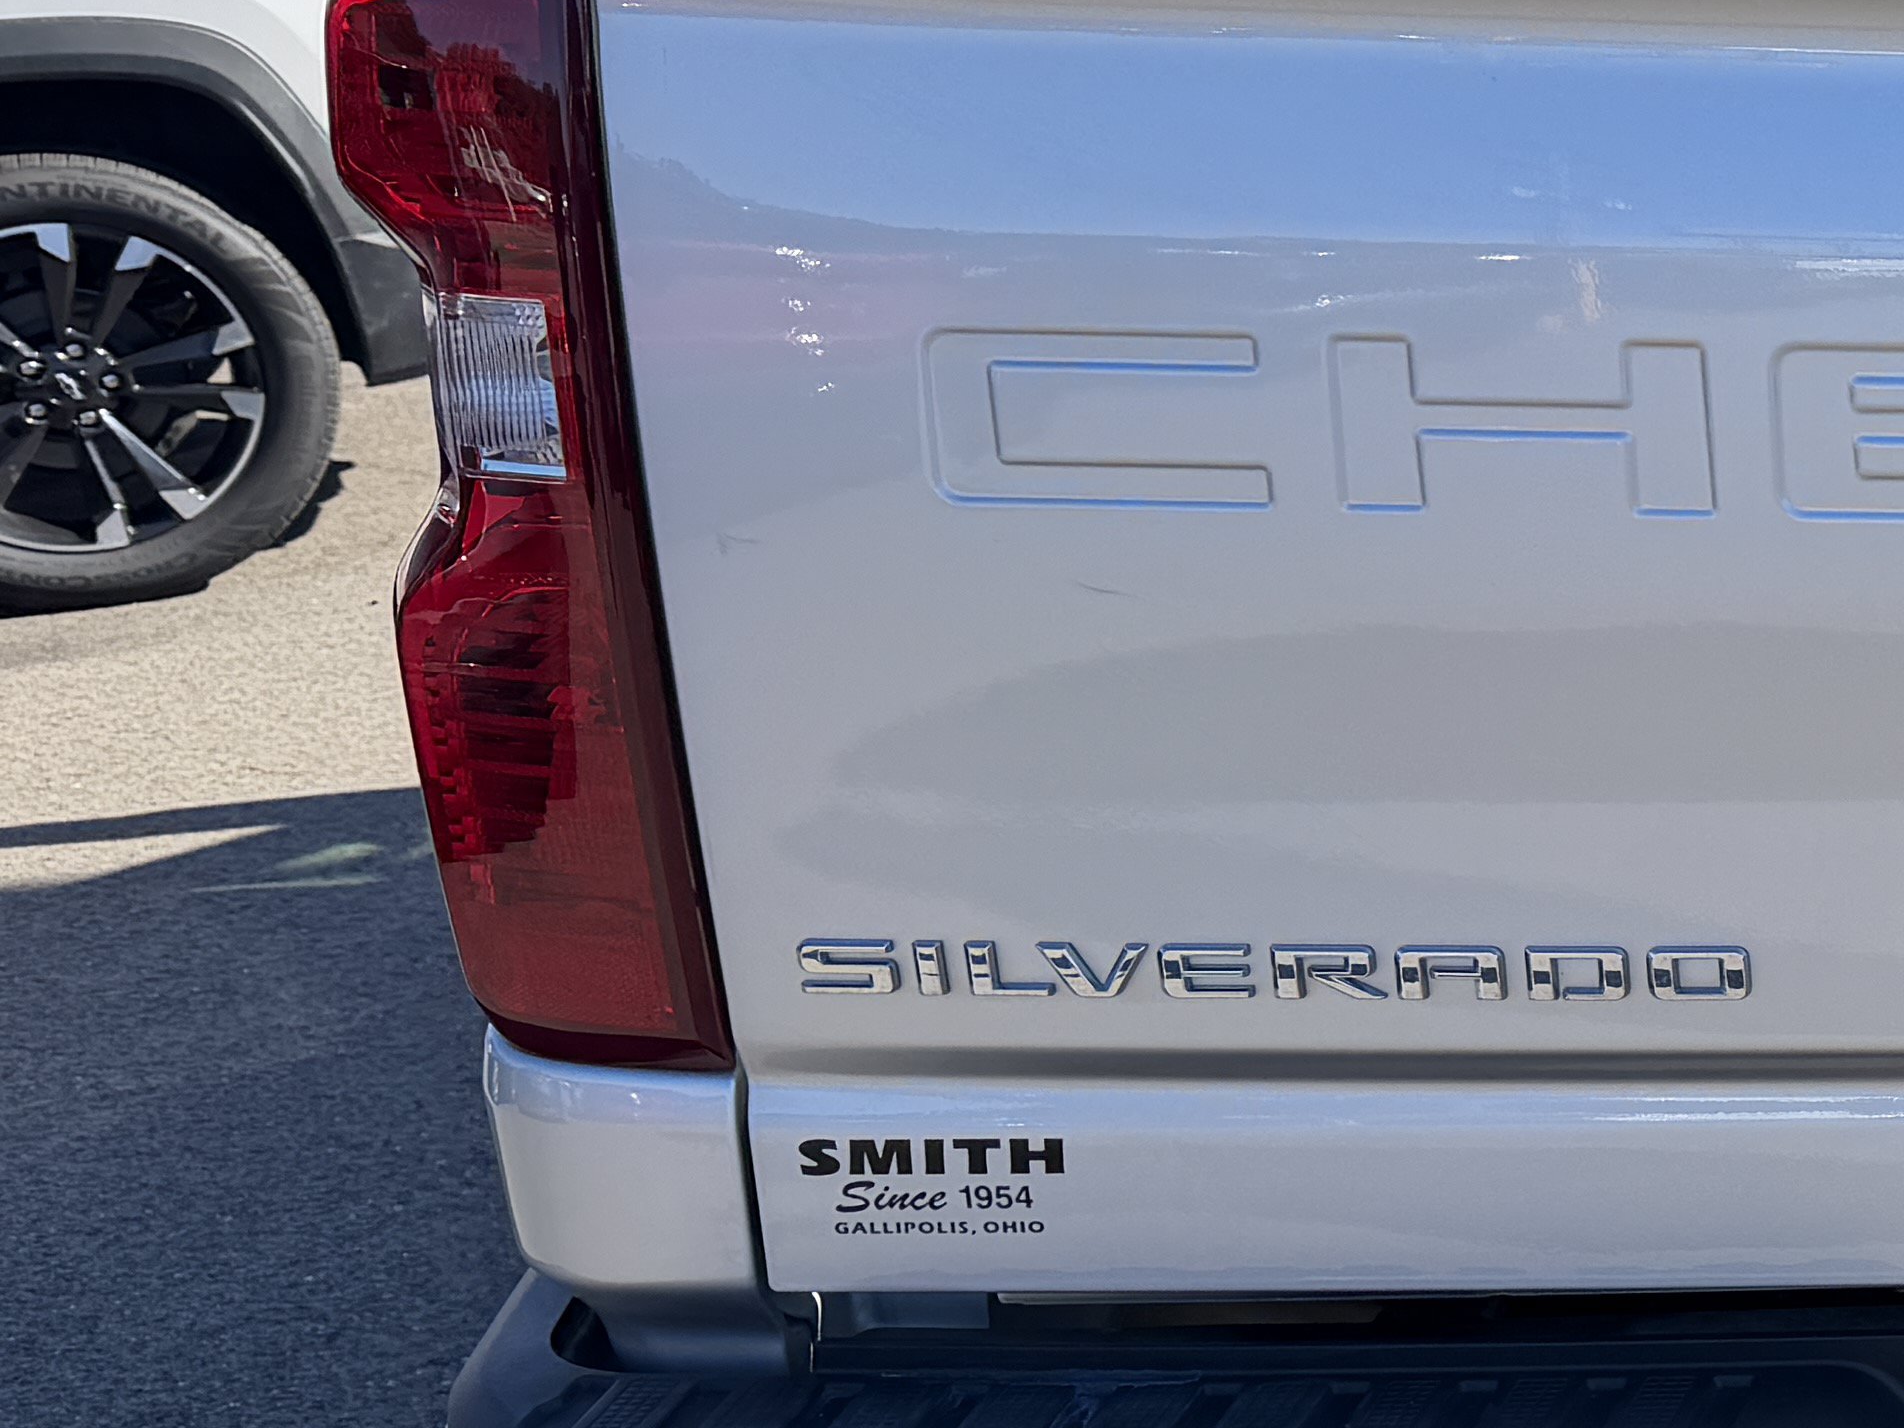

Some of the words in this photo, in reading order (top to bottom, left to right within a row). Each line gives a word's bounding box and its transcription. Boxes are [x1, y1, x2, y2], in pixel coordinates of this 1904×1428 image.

[797, 936, 1752, 1004] SILVERADO
[798, 1138, 1065, 1176] SMITH
[836, 1180, 948, 1213] Since
[959, 1185, 1034, 1209] 1954
[835, 1221, 977, 1235] GALLIPOLIS,
[983, 1221, 1045, 1233] OHIO
